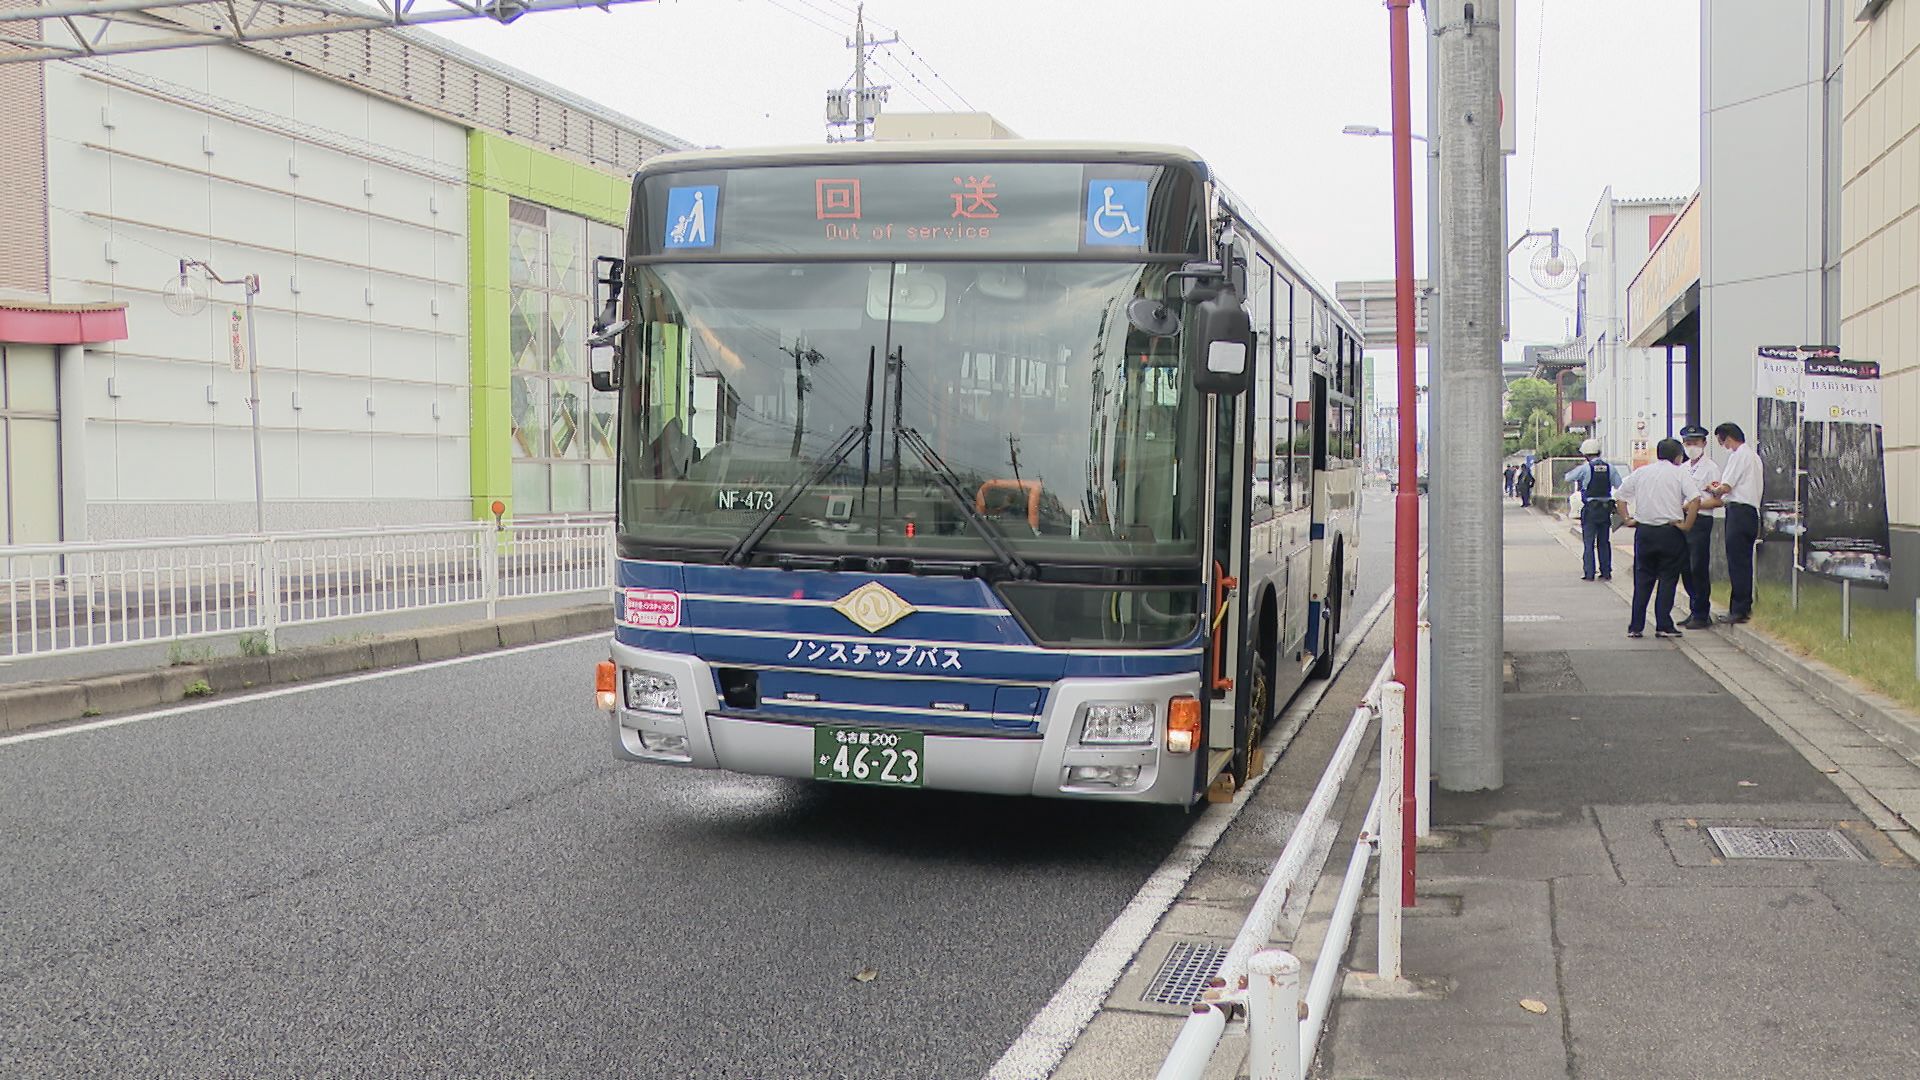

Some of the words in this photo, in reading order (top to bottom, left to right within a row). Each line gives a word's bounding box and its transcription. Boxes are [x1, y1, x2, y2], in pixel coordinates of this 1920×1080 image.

[815, 178, 861, 220] 回
[950, 175, 1000, 219] 送
[825, 223, 860, 241] Out
[872, 223, 894, 241] of
[906, 222, 992, 241] service
[719, 490, 774, 510] NF-473
[787, 640, 962, 670] ノンステップバス
[871, 733, 898, 747] 200
[833, 745, 918, 783] 46-23
